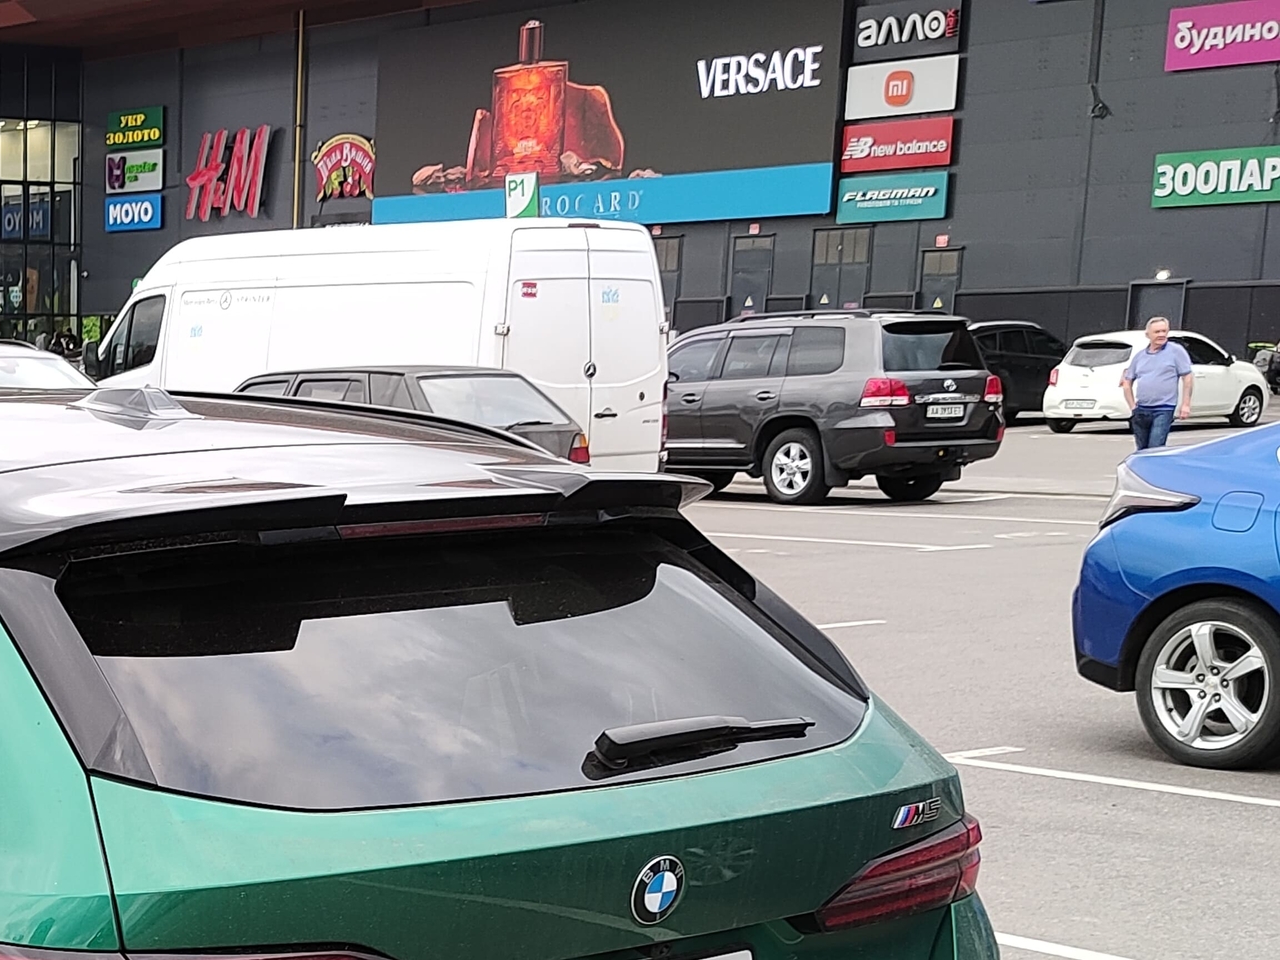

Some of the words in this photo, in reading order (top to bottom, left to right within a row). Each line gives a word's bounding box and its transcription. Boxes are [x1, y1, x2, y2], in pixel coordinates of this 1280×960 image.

[697, 45, 823, 98] VERSACE
[120, 113, 145, 128] УКР
[106, 128, 160, 145] ЗОЛОТО
[871, 145, 896, 157] new
[896, 139, 947, 155] balance
[186, 123, 270, 222] H&M
[1154, 155, 1280, 197] ЗООПАР
[508, 179, 524, 197] P1
[842, 187, 936, 202] FLAGMAN
[108, 201, 153, 225] MOYO
[541, 189, 640, 216] ROCARD
[642, 859, 684, 884] BMW
